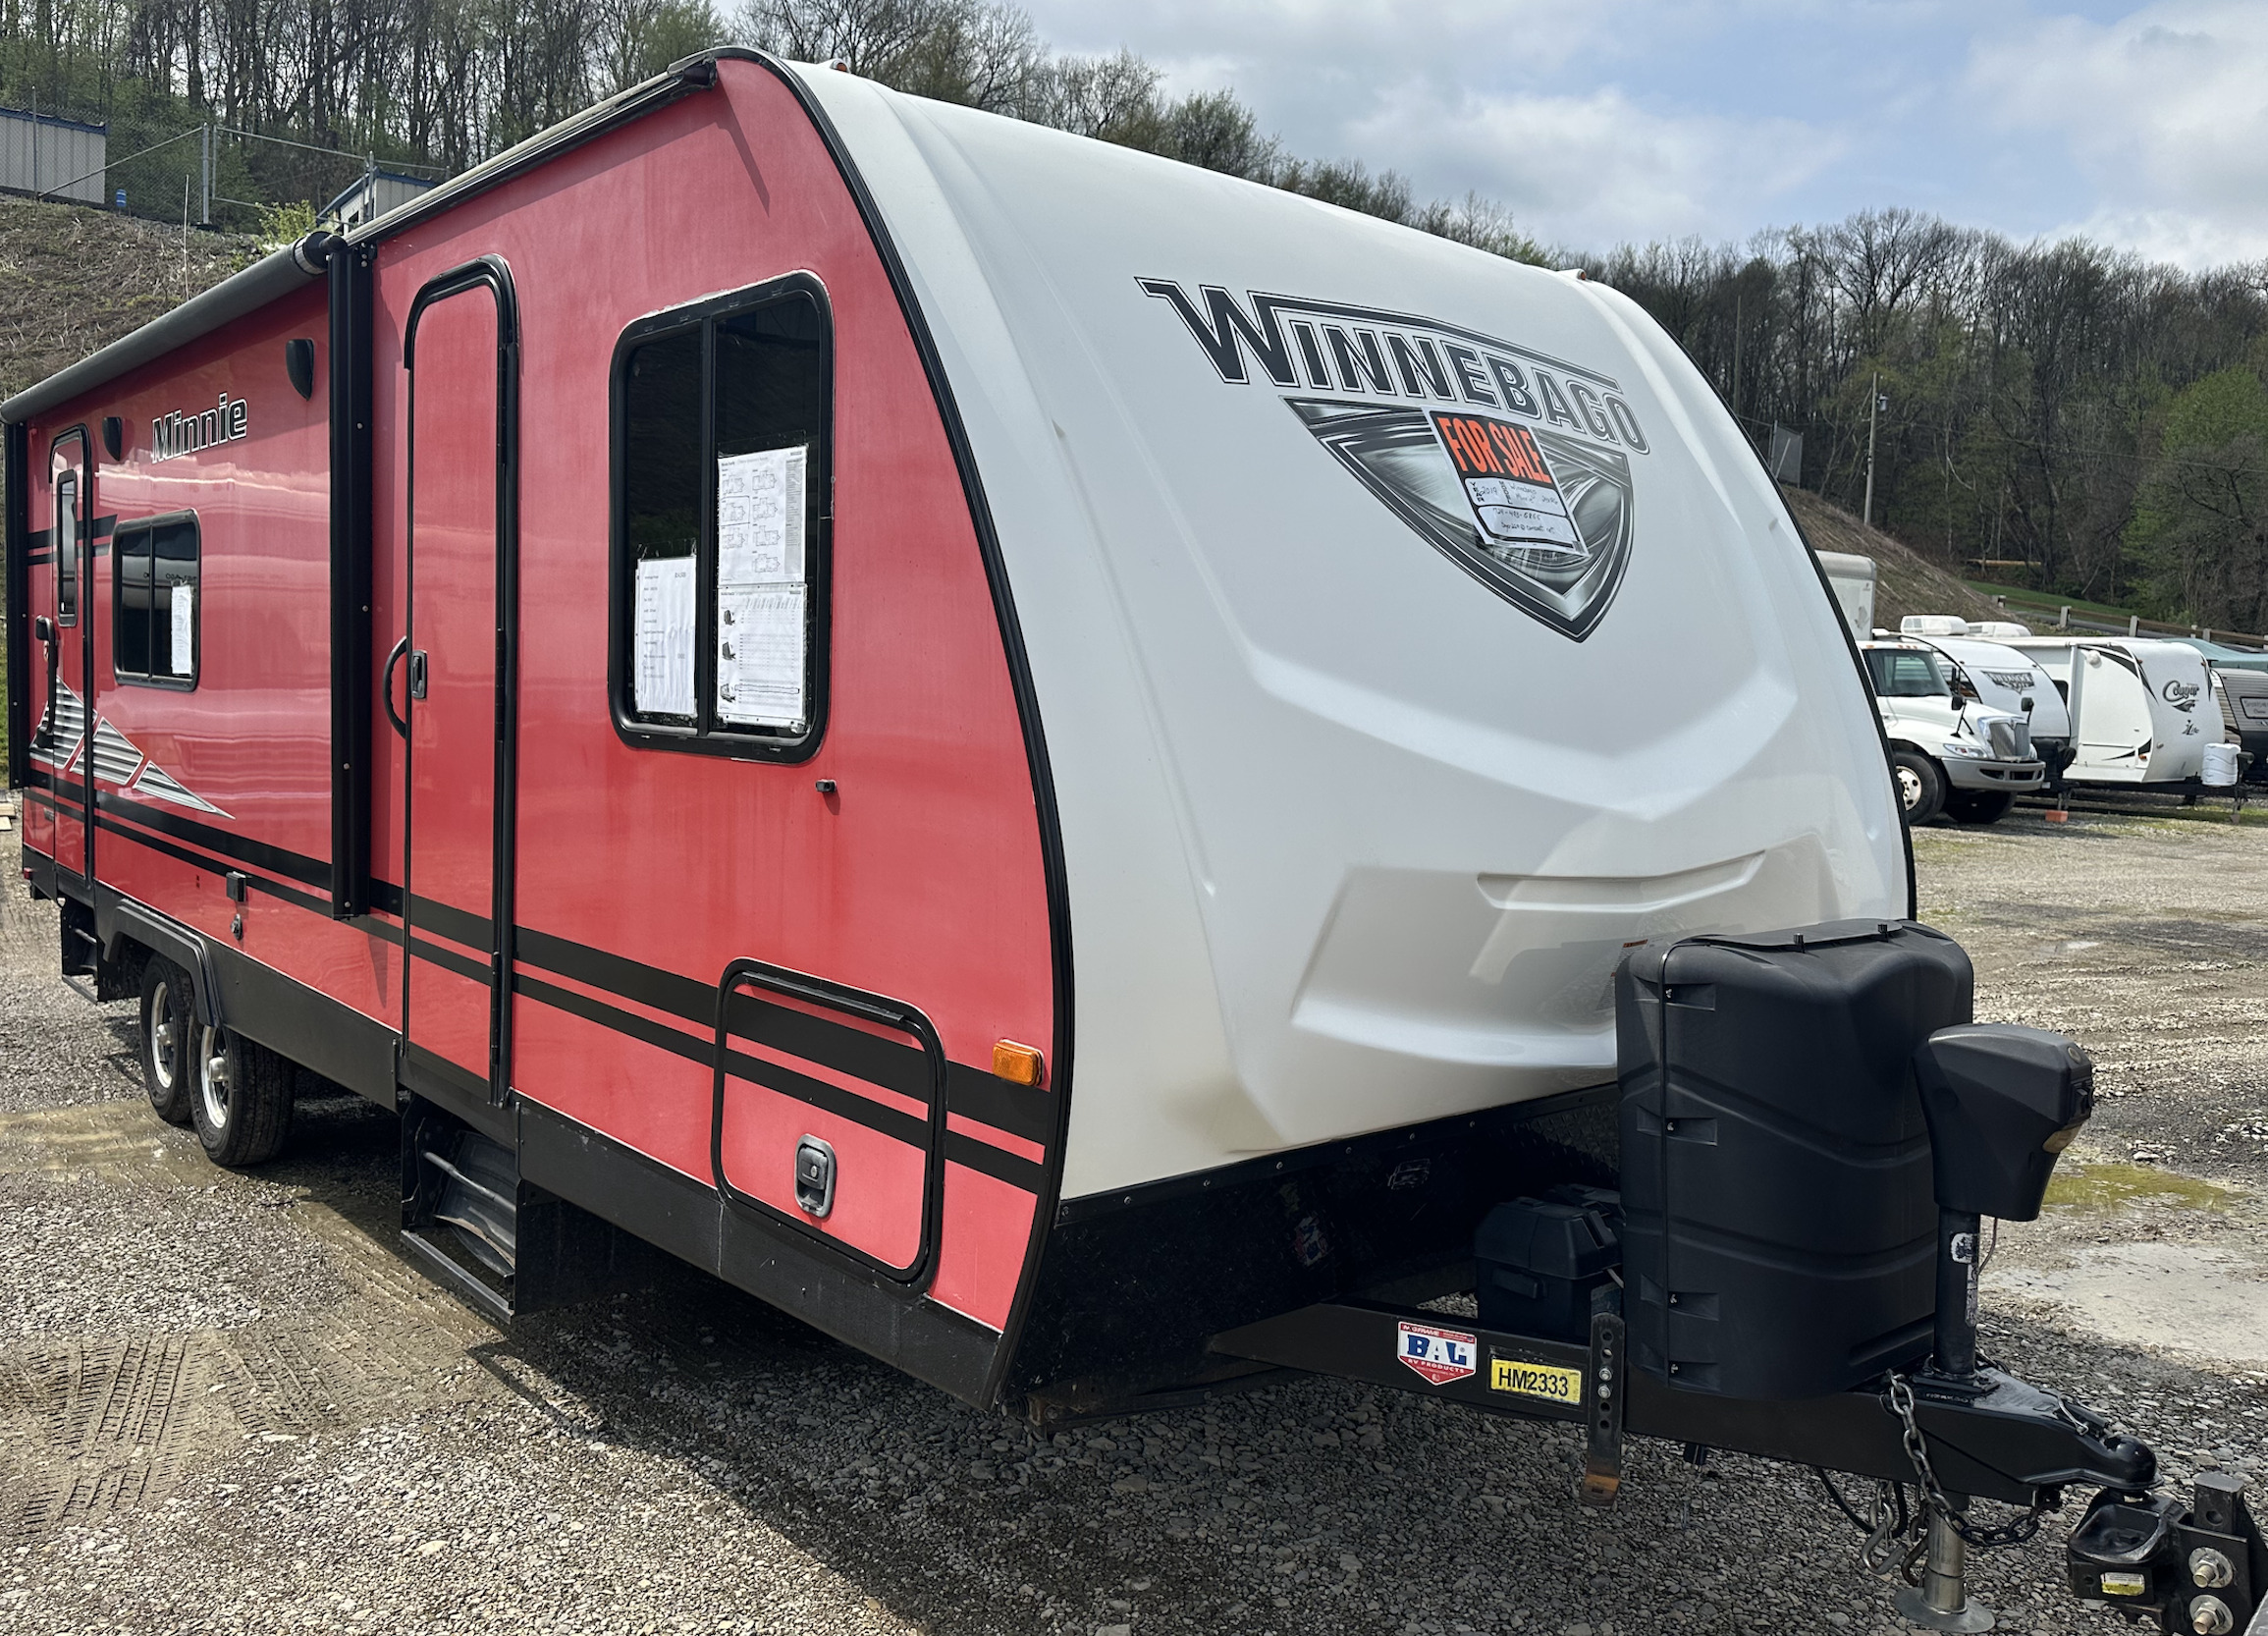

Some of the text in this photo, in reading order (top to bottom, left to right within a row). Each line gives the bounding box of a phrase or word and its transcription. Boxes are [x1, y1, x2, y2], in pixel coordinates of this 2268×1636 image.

[1133, 276, 1650, 455] WINNEBAGO
[151, 392, 248, 464] Minnie
[1436, 416, 1552, 484] FOR SALE
[2162, 680, 2199, 702] Cougar
[1407, 1335, 1467, 1366] BAL
[1421, 1361, 1465, 1374] PRODUCTS
[1498, 1367, 1569, 1397] HM2333
